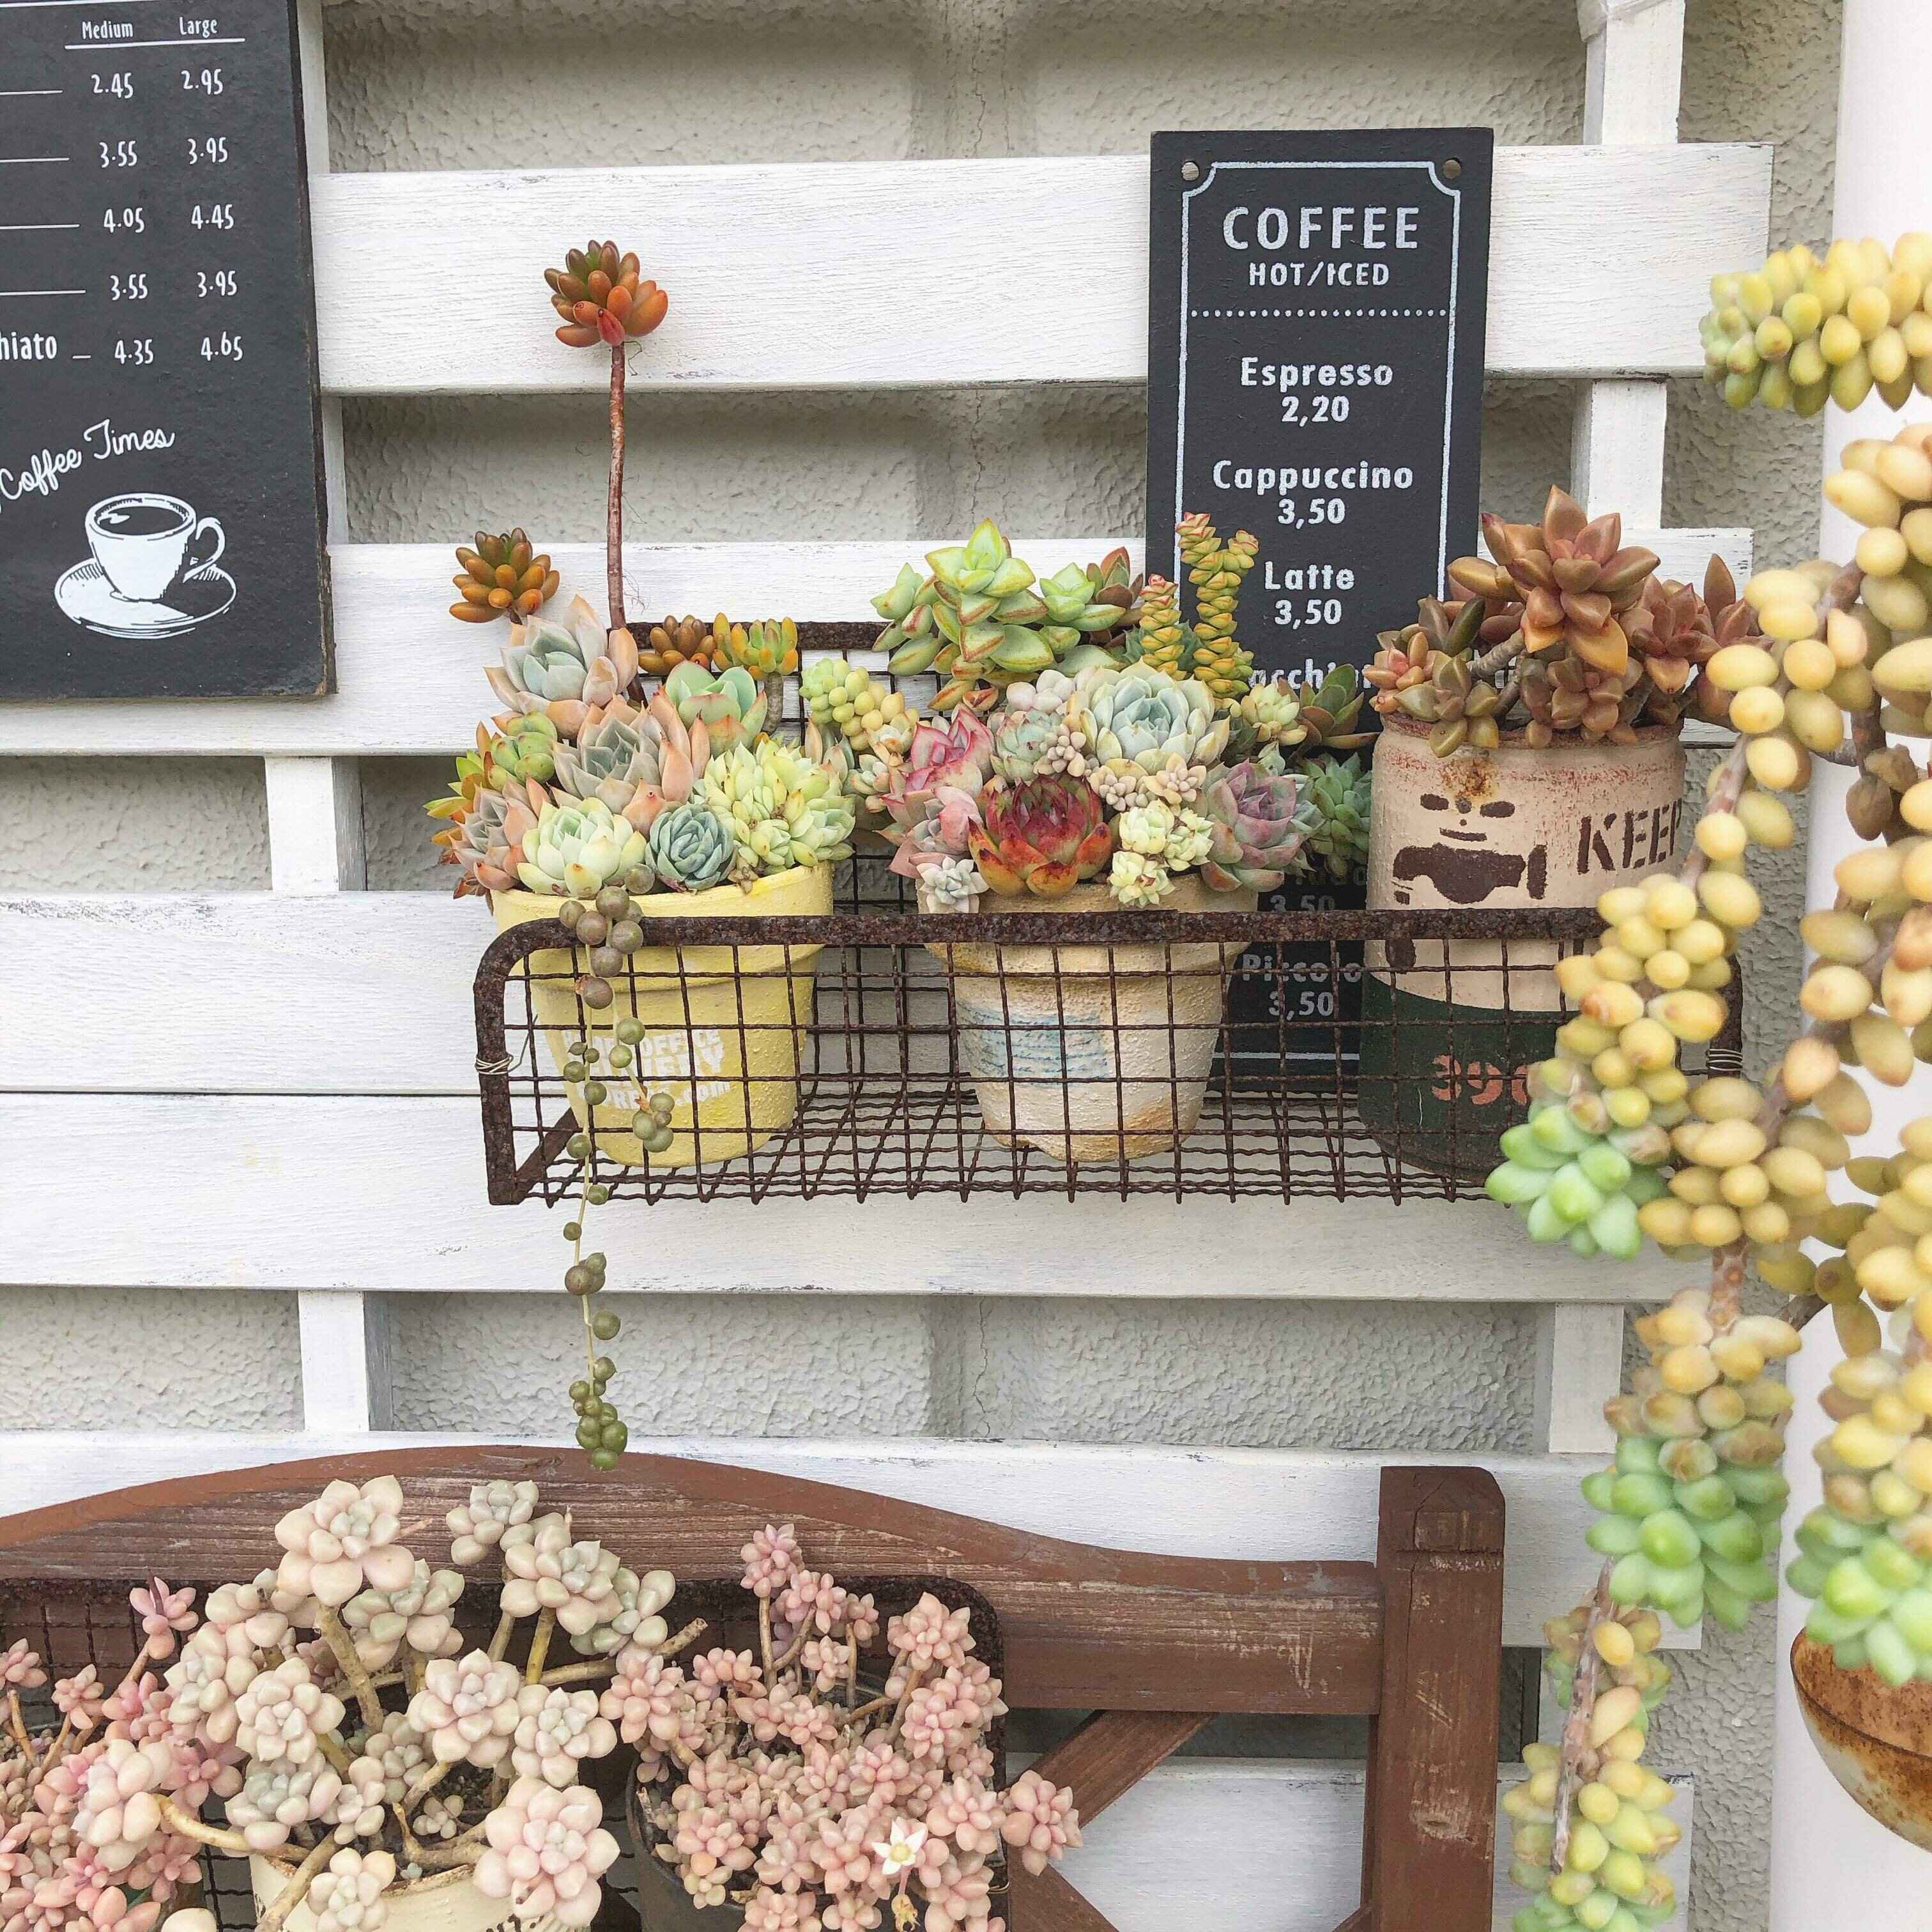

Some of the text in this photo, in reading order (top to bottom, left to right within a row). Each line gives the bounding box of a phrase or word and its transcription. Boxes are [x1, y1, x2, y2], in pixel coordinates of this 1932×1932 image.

[82, 17, 218, 40] Medium Large
[91, 68, 224, 99] 2.45 2.95
[99, 137, 229, 168] 3.55 3.95
[103, 204, 235, 233] 4.05 4.45
[1222, 206, 1420, 250] COFFEE
[109, 270, 238, 301] 3.55 3.95
[1248, 261, 1390, 287] HOT/ICED
[114, 338, 155, 365] 4.35
[200, 330, 243, 362] 4.65
[1240, 356, 1394, 393] Espresso
[1281, 394, 1351, 428] 2,20
[0, 418, 176, 500] Coffee Times
[1212, 459, 1414, 496] Cappuccino
[1276, 497, 1346, 530] 3,50
[1264, 560, 1356, 591] Latte
[1274, 598, 1343, 631] 3,50
[1268, 991, 1335, 1022] 3,50
